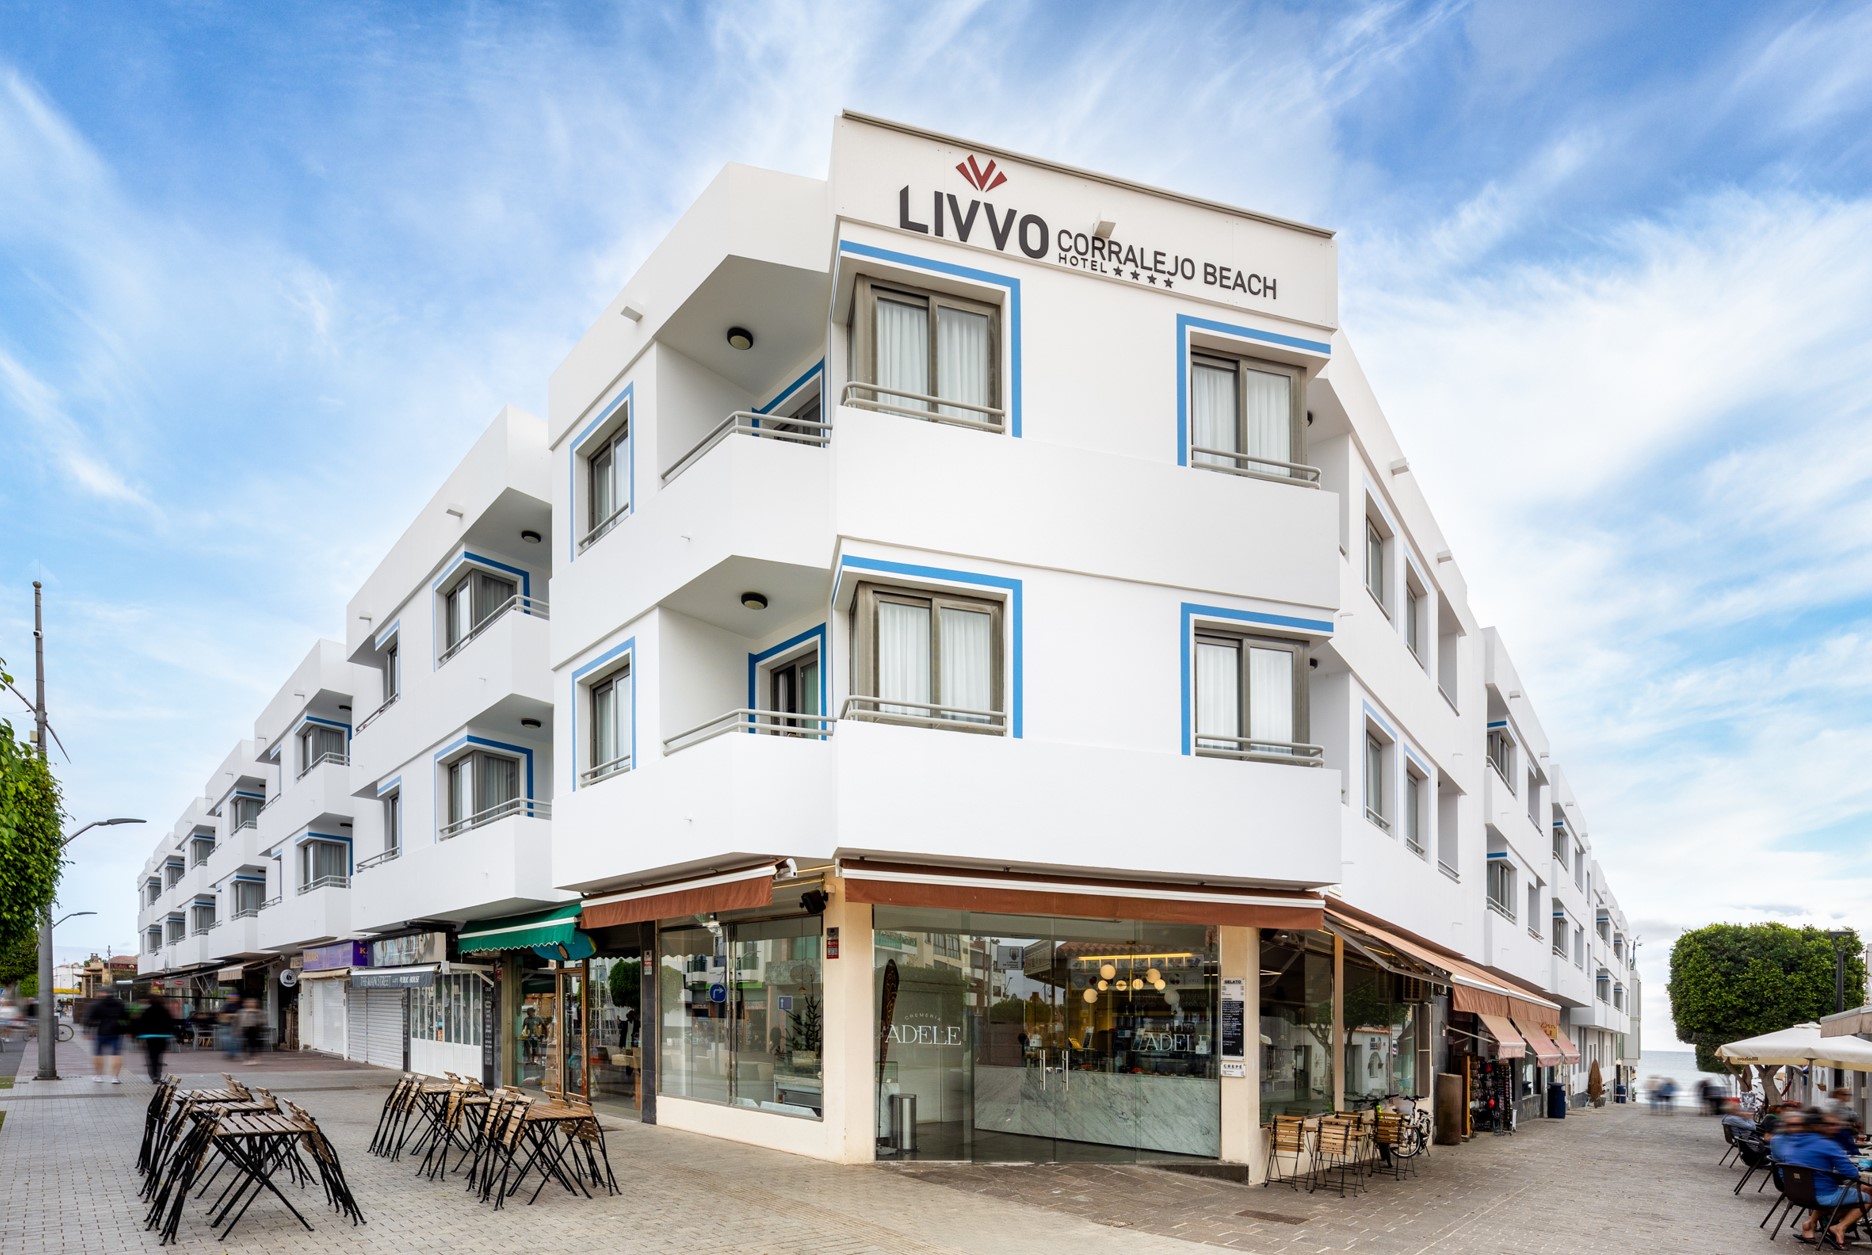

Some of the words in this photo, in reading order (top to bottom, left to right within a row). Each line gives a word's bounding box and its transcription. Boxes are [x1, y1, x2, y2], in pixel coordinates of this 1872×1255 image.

[899, 184, 1050, 260] LIVVO
[1057, 229, 1196, 281] CORRALEJO
[1203, 262, 1278, 300] BEACH
[1058, 252, 1108, 274] HOTEL
[884, 1024, 962, 1046] ADELE
